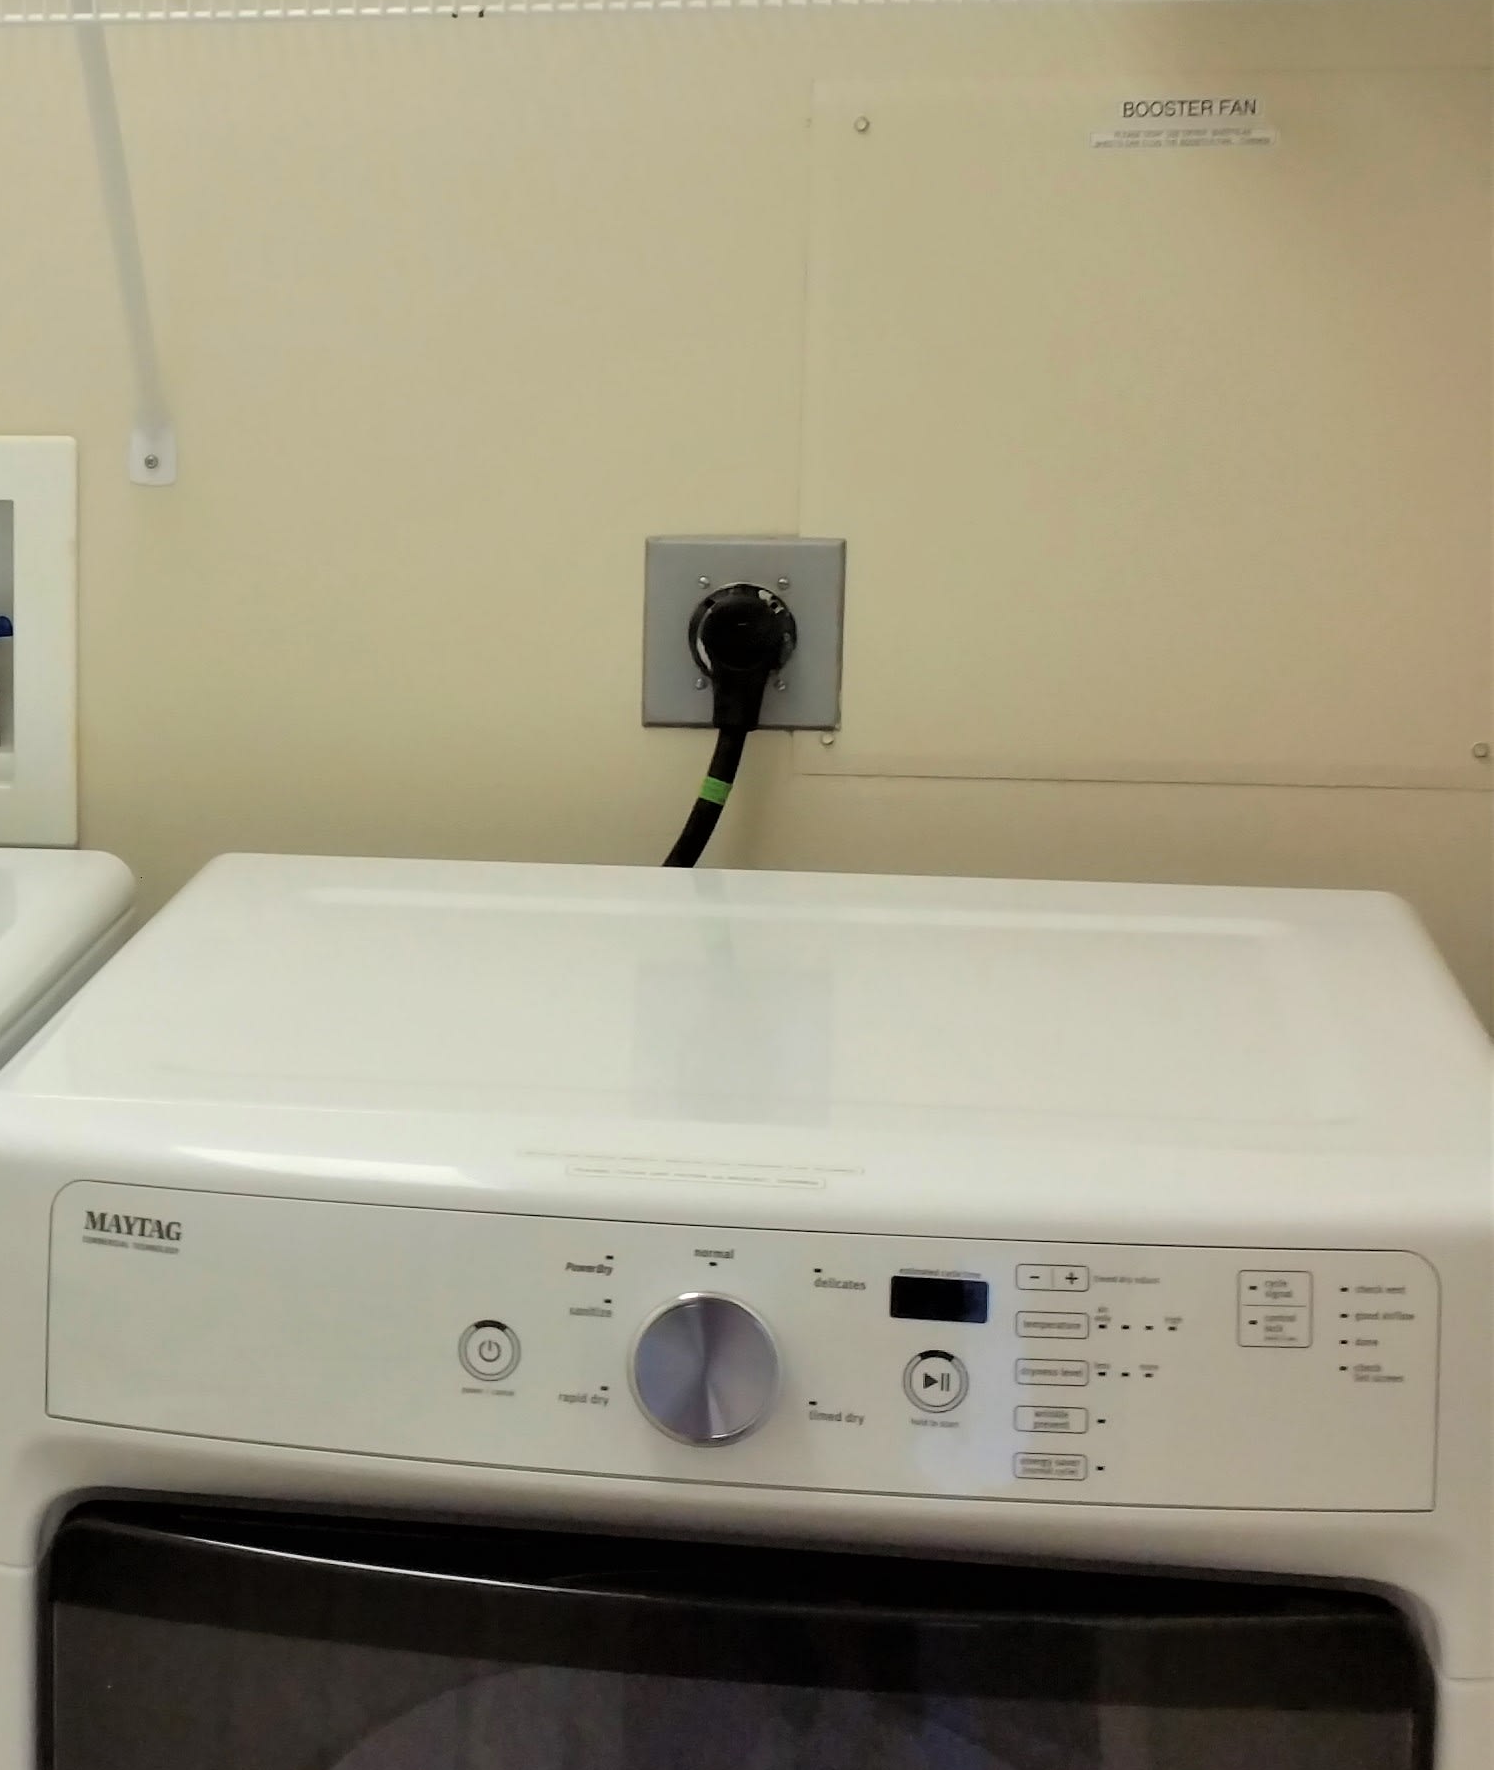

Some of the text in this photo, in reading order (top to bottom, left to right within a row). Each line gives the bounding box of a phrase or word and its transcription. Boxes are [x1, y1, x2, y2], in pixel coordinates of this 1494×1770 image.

[1122, 98, 1257, 118] BOOSTER FAN
[84, 1210, 182, 1241] MAYTAG
[693, 1248, 735, 1259] normal
[814, 1277, 867, 1290] delicates
